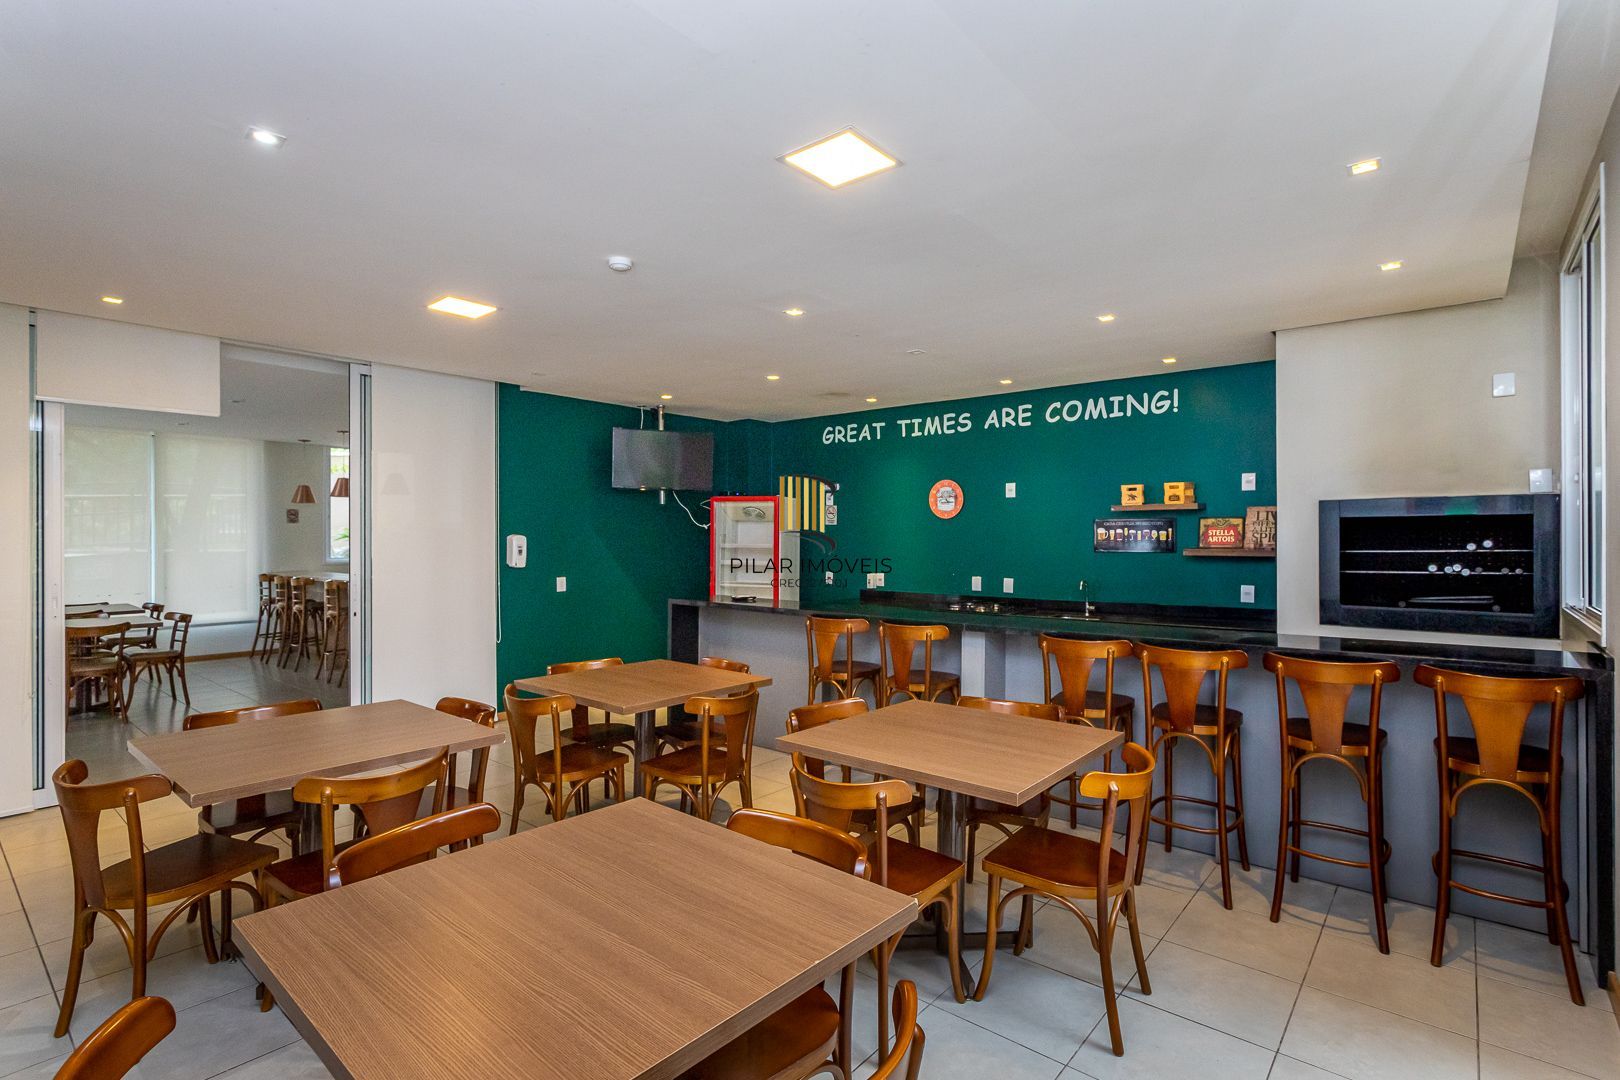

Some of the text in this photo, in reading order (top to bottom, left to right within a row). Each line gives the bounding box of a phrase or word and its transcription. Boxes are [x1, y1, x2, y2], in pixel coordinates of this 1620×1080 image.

[822, 388, 1179, 445] GREAT TIMES ARE COMING!
[1207, 535, 1235, 543] ARTOIS
